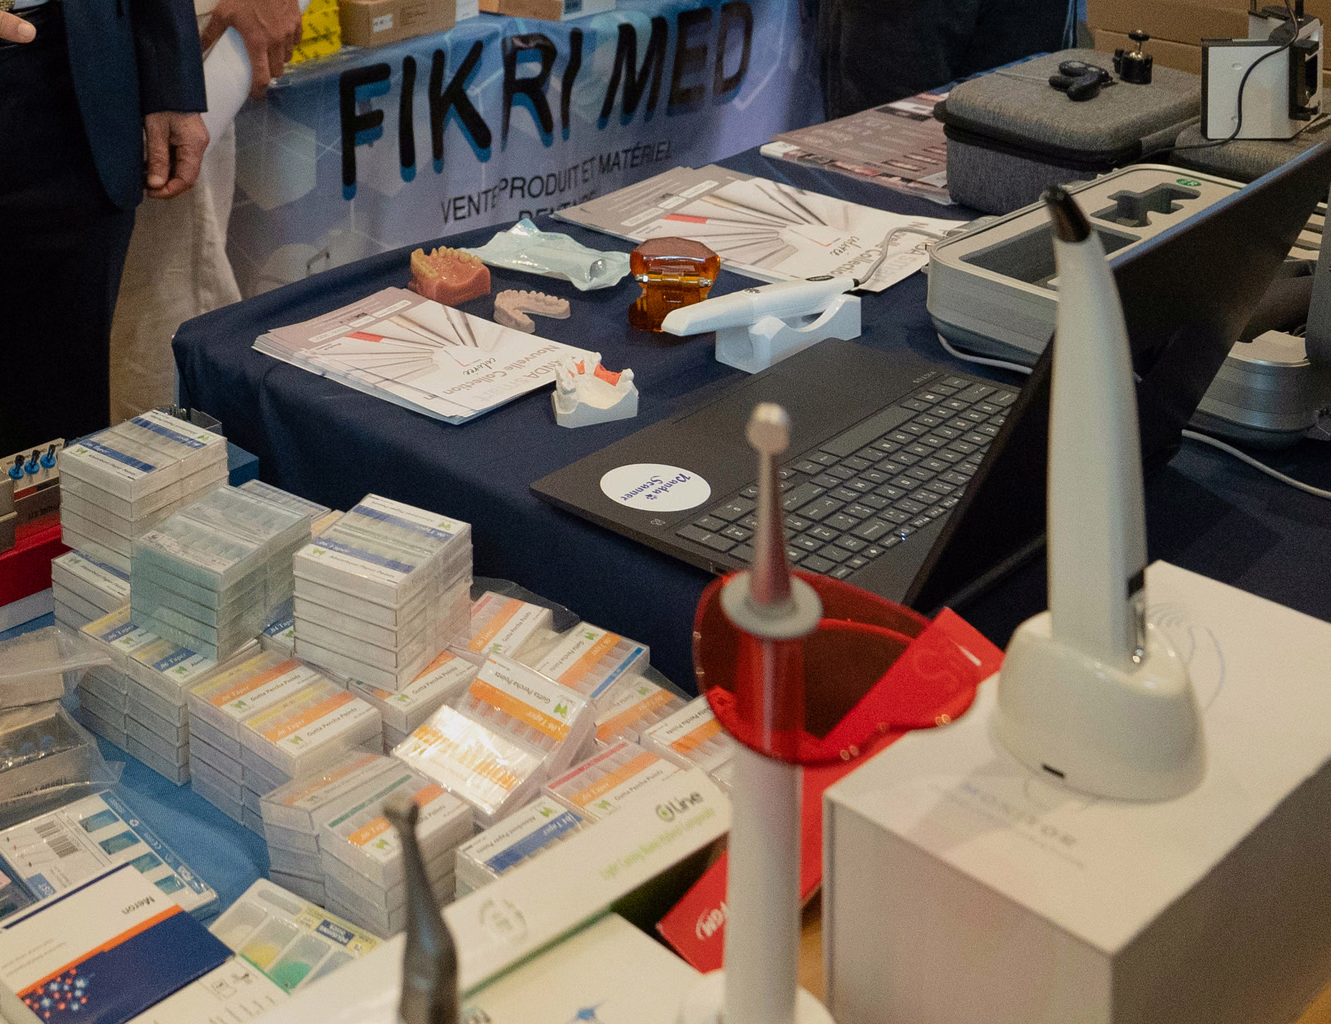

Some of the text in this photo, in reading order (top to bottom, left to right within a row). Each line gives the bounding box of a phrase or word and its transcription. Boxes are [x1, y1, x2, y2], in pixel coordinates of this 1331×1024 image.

[340, 0, 754, 200] FIKRI MED
[441, 188, 499, 225] VENTE
[498, 167, 581, 202] PRODUIT
[443, 344, 562, 395] Nouvelle Collection
[620, 475, 663, 501] Scanner
[652, 473, 691, 496] Panda
[307, 706, 357, 738] Gutta Percha Points
[121, 896, 155, 915] Meron
